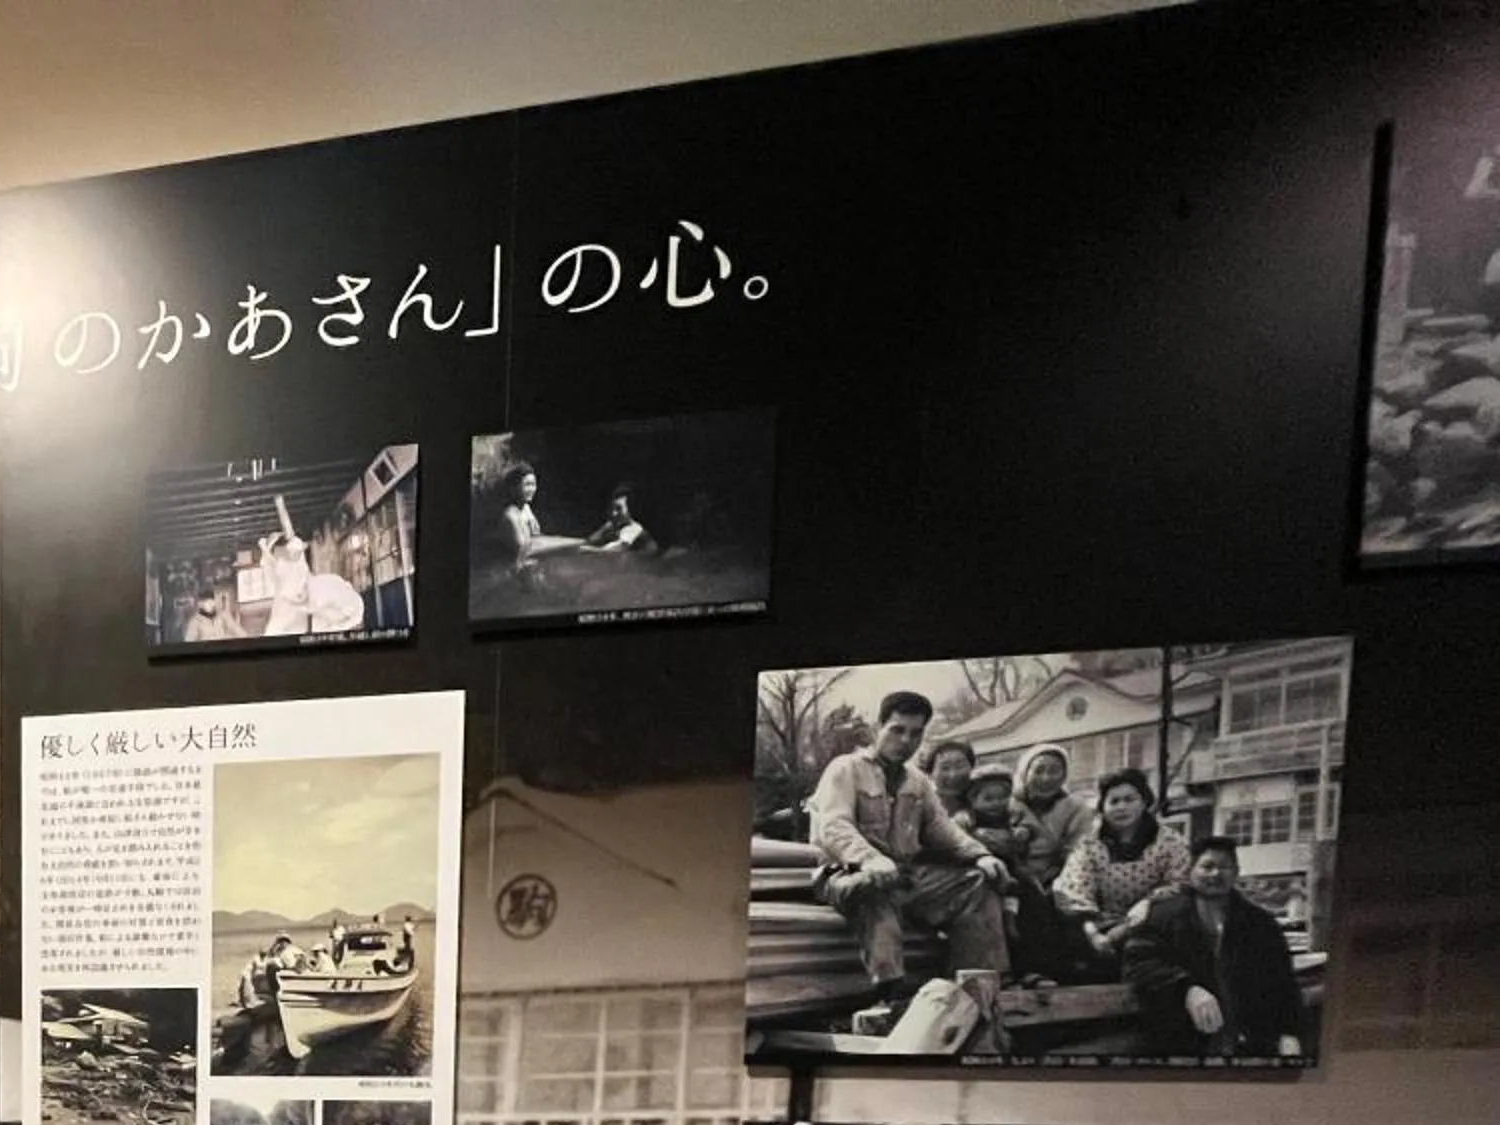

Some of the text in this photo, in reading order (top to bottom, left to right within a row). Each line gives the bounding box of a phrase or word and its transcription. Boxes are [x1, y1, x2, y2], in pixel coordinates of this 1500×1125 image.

[40, 722, 258, 759] 優しく厳しい大自然
